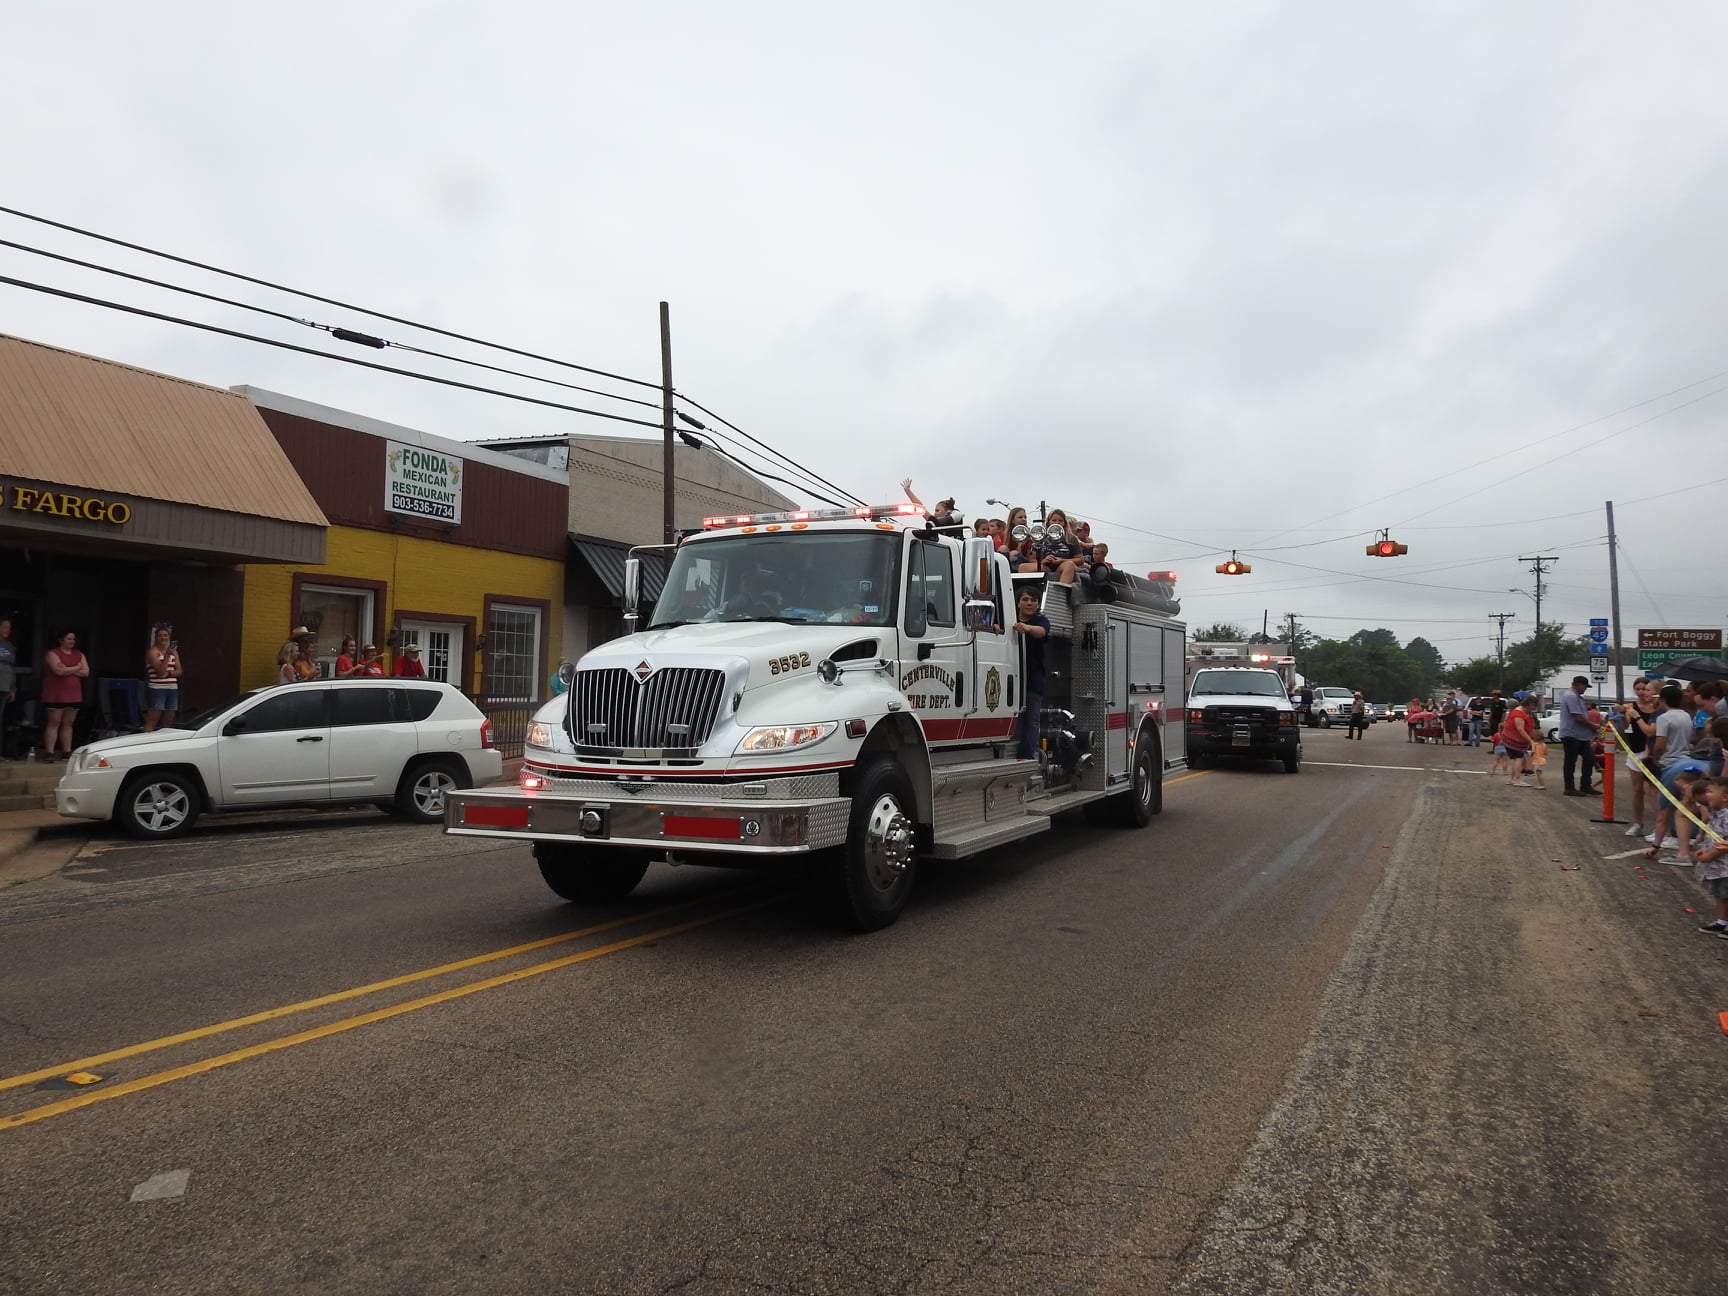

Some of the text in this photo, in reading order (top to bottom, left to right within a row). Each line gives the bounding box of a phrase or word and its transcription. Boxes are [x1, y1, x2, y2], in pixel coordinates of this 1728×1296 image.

[403, 449, 447, 475] FONDA
[403, 468, 447, 488] MEXICAN
[392, 481, 456, 504] RESTAURANT
[12, 487, 131, 524] FARGO
[393, 495, 453, 517] 903-536-7734
[1642, 640, 1697, 648] State Park
[1683, 632, 1716, 641] Boggy
[768, 651, 811, 675] 3532
[1642, 652, 1665, 660] Leon
[902, 665, 955, 692] CENTERVILLE
[929, 695, 950, 709] DEPT.
